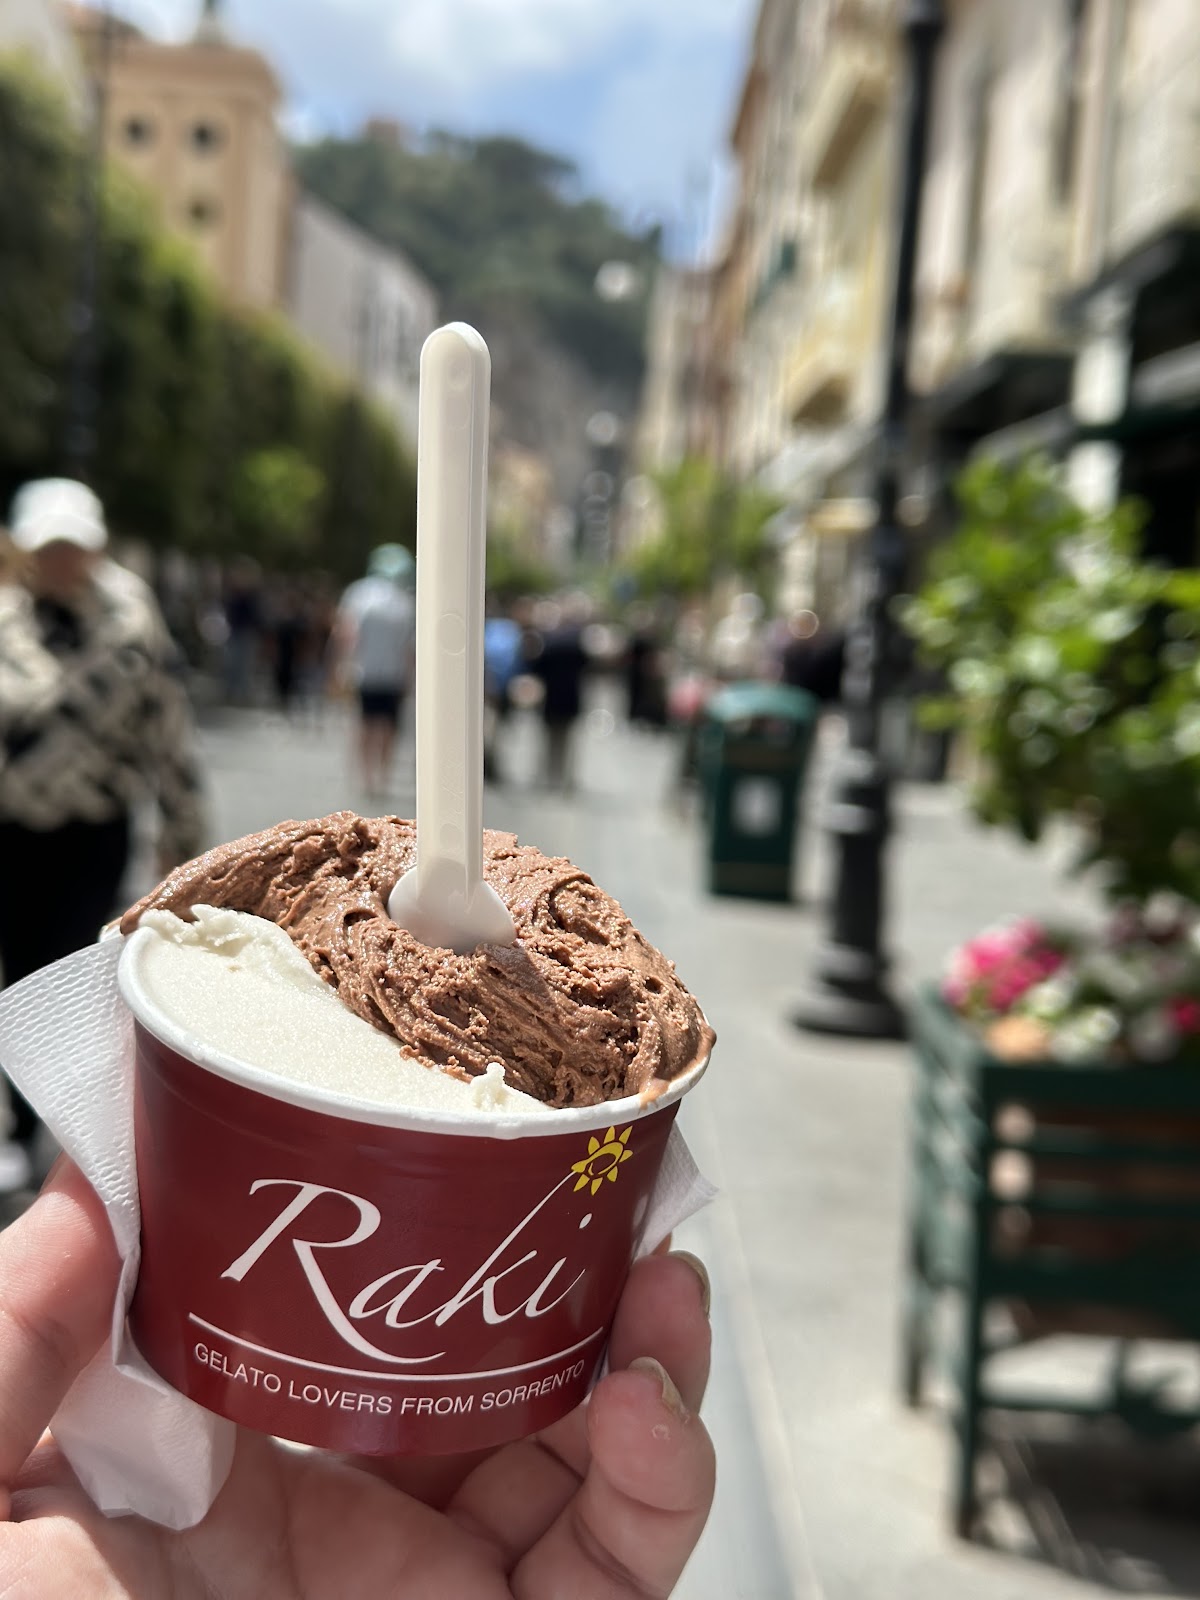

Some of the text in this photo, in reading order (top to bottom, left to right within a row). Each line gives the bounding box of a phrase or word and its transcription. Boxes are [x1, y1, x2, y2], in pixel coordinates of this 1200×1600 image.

[220, 1168, 593, 1364] Raki
[194, 1342, 587, 1415] GELATO LOVERS FROM SORRENTO
